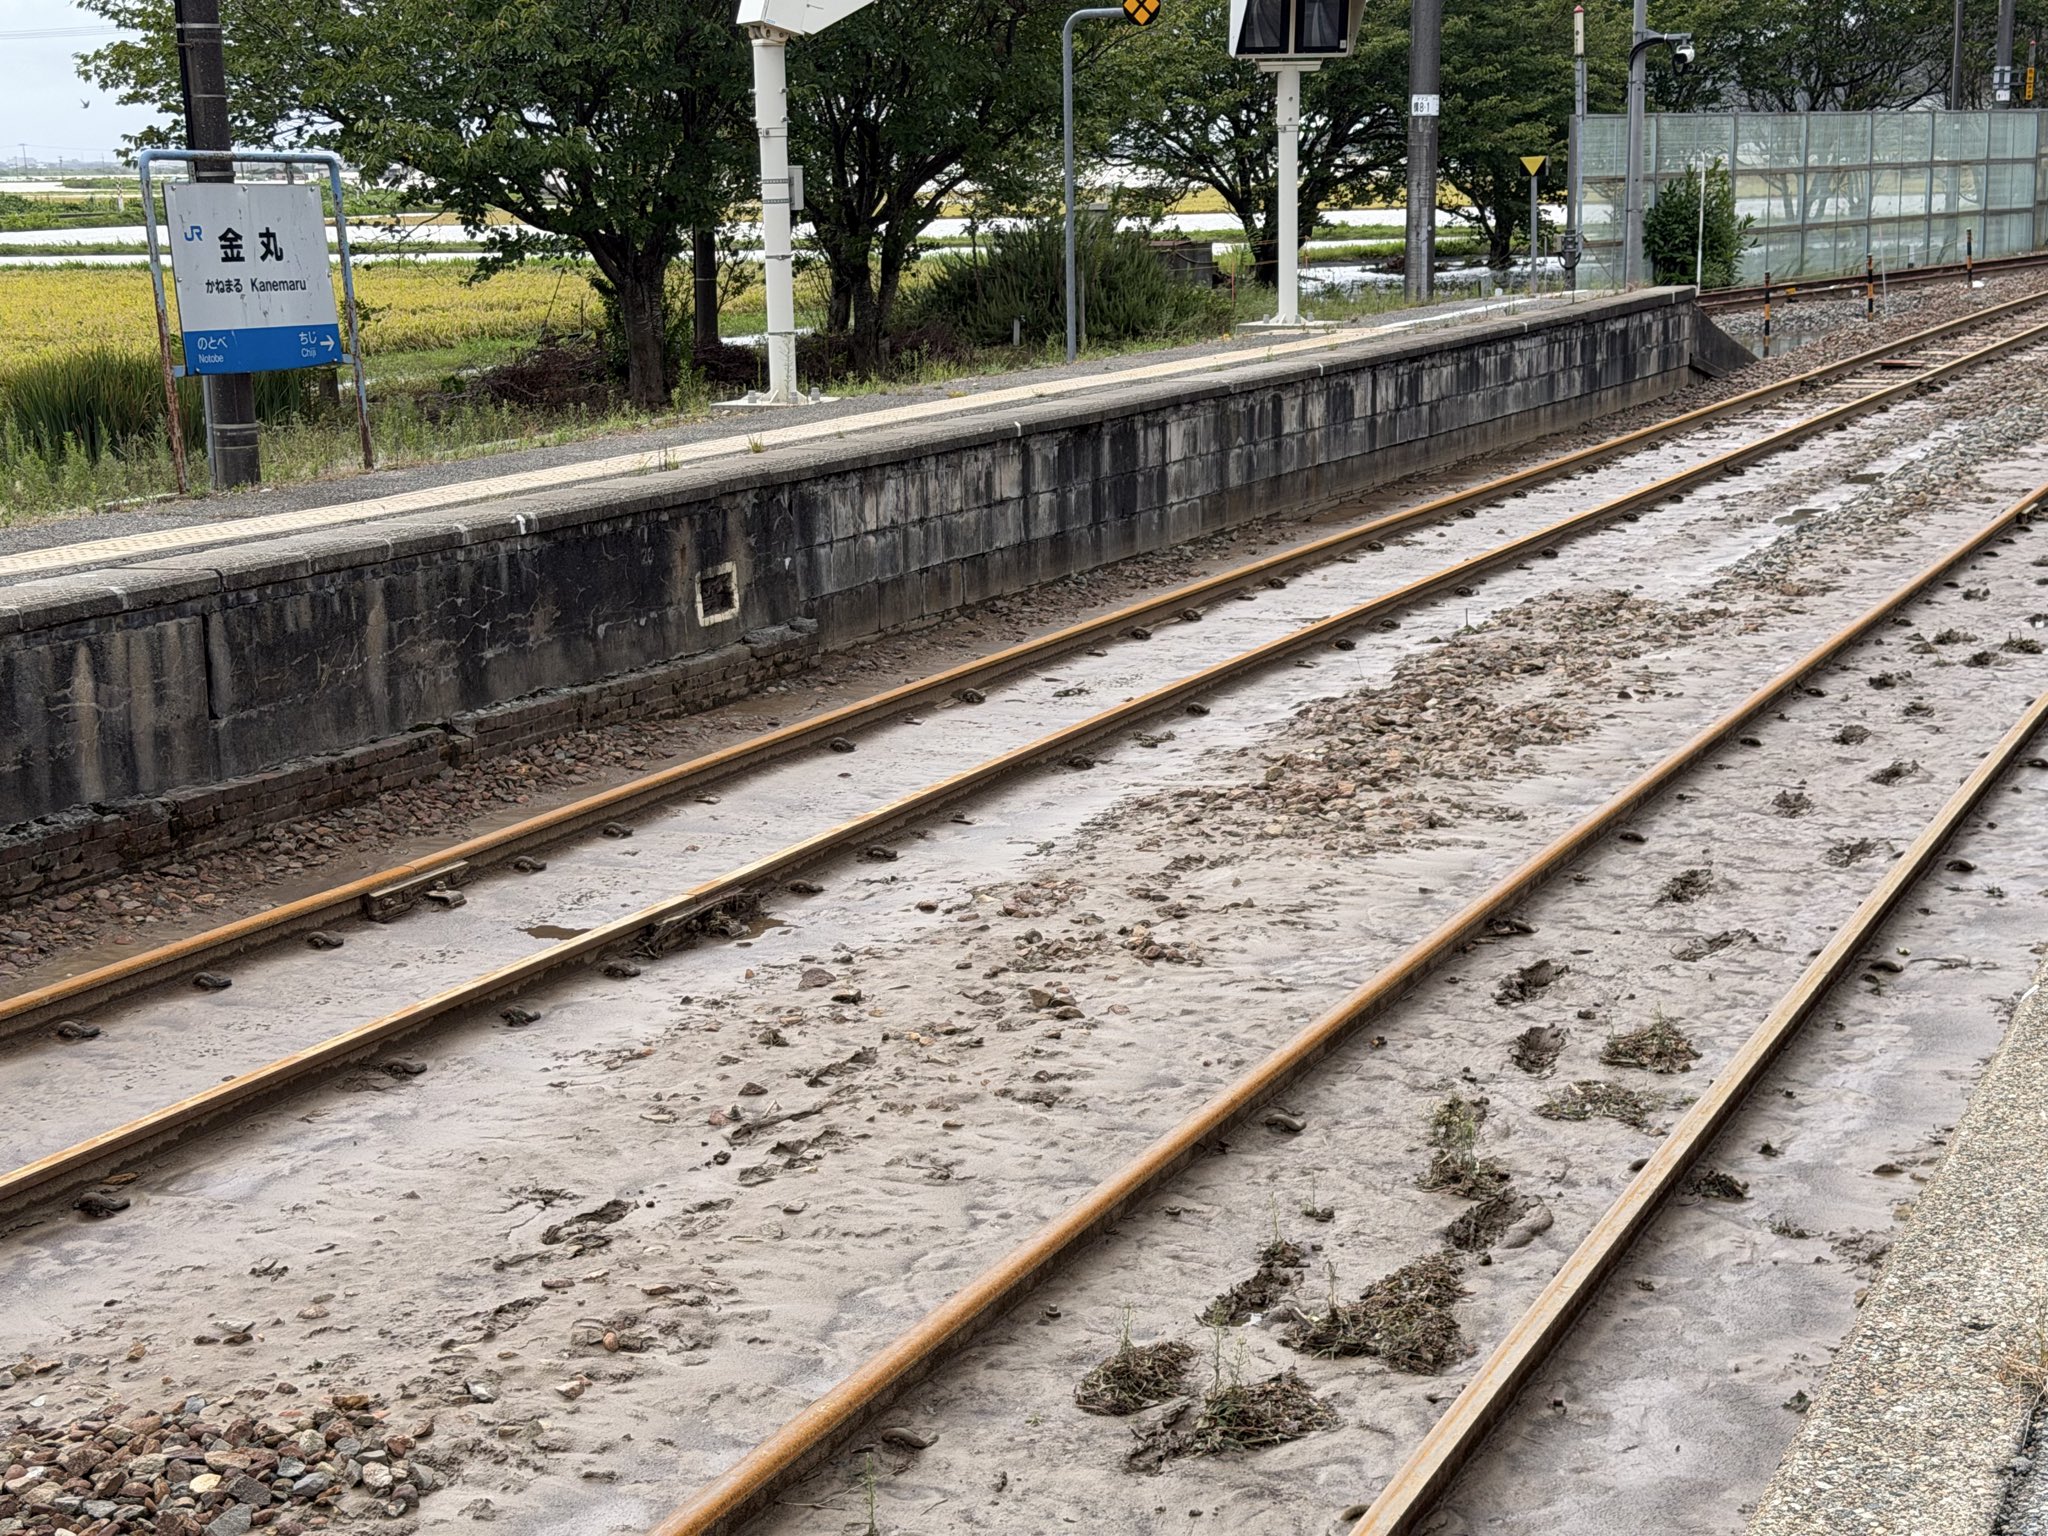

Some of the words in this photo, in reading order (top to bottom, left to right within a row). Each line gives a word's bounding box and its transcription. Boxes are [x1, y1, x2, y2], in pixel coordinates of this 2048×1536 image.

[184, 225, 203, 242] JR
[218, 226, 284, 263] 金丸
[205, 278, 243, 294] かねまる
[250, 277, 307, 293] Kanemaru
[197, 336, 228, 351] のとべ
[299, 331, 317, 345] ちじ
[198, 352, 225, 364] Notobe
